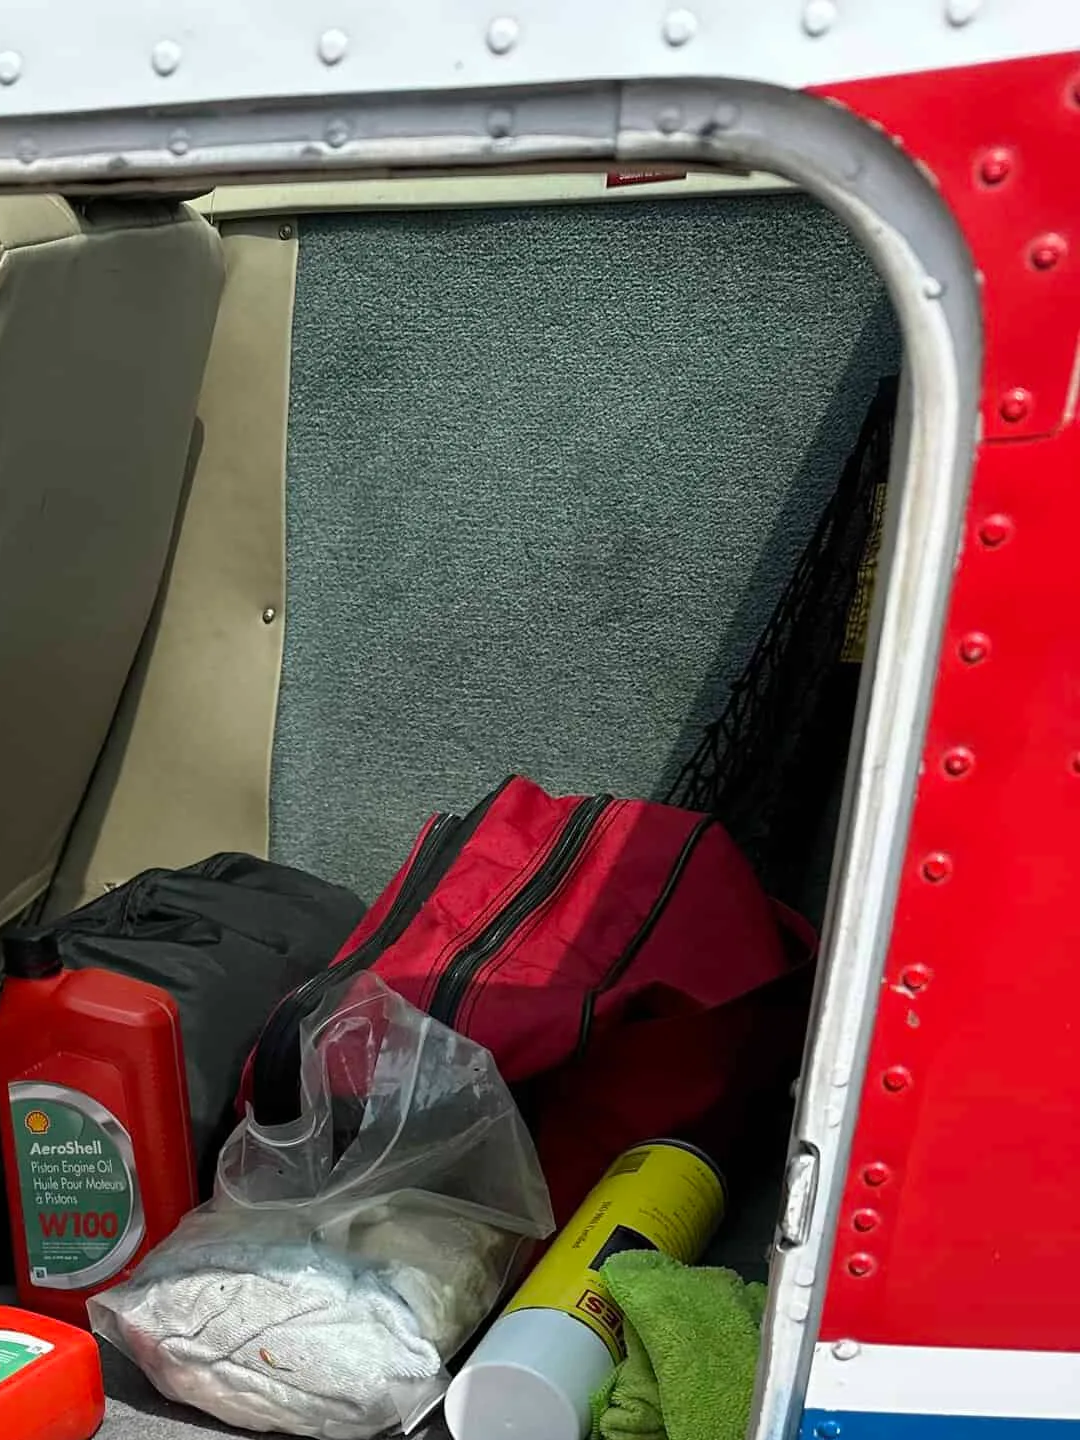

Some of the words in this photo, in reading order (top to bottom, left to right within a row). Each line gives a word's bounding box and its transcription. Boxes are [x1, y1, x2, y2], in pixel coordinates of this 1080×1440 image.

[30, 1140, 102, 1155] AeroShell
[31, 1161, 60, 1174] Piston
[62, 1160, 96, 1177] Engine
[97, 1159, 114, 1174] Oil
[33, 1176, 59, 1191] Huile
[61, 1177, 83, 1191] Pour
[86, 1177, 125, 1191] Moteurs
[45, 1192, 79, 1205] Pistons
[38, 1211, 119, 1239] W100
